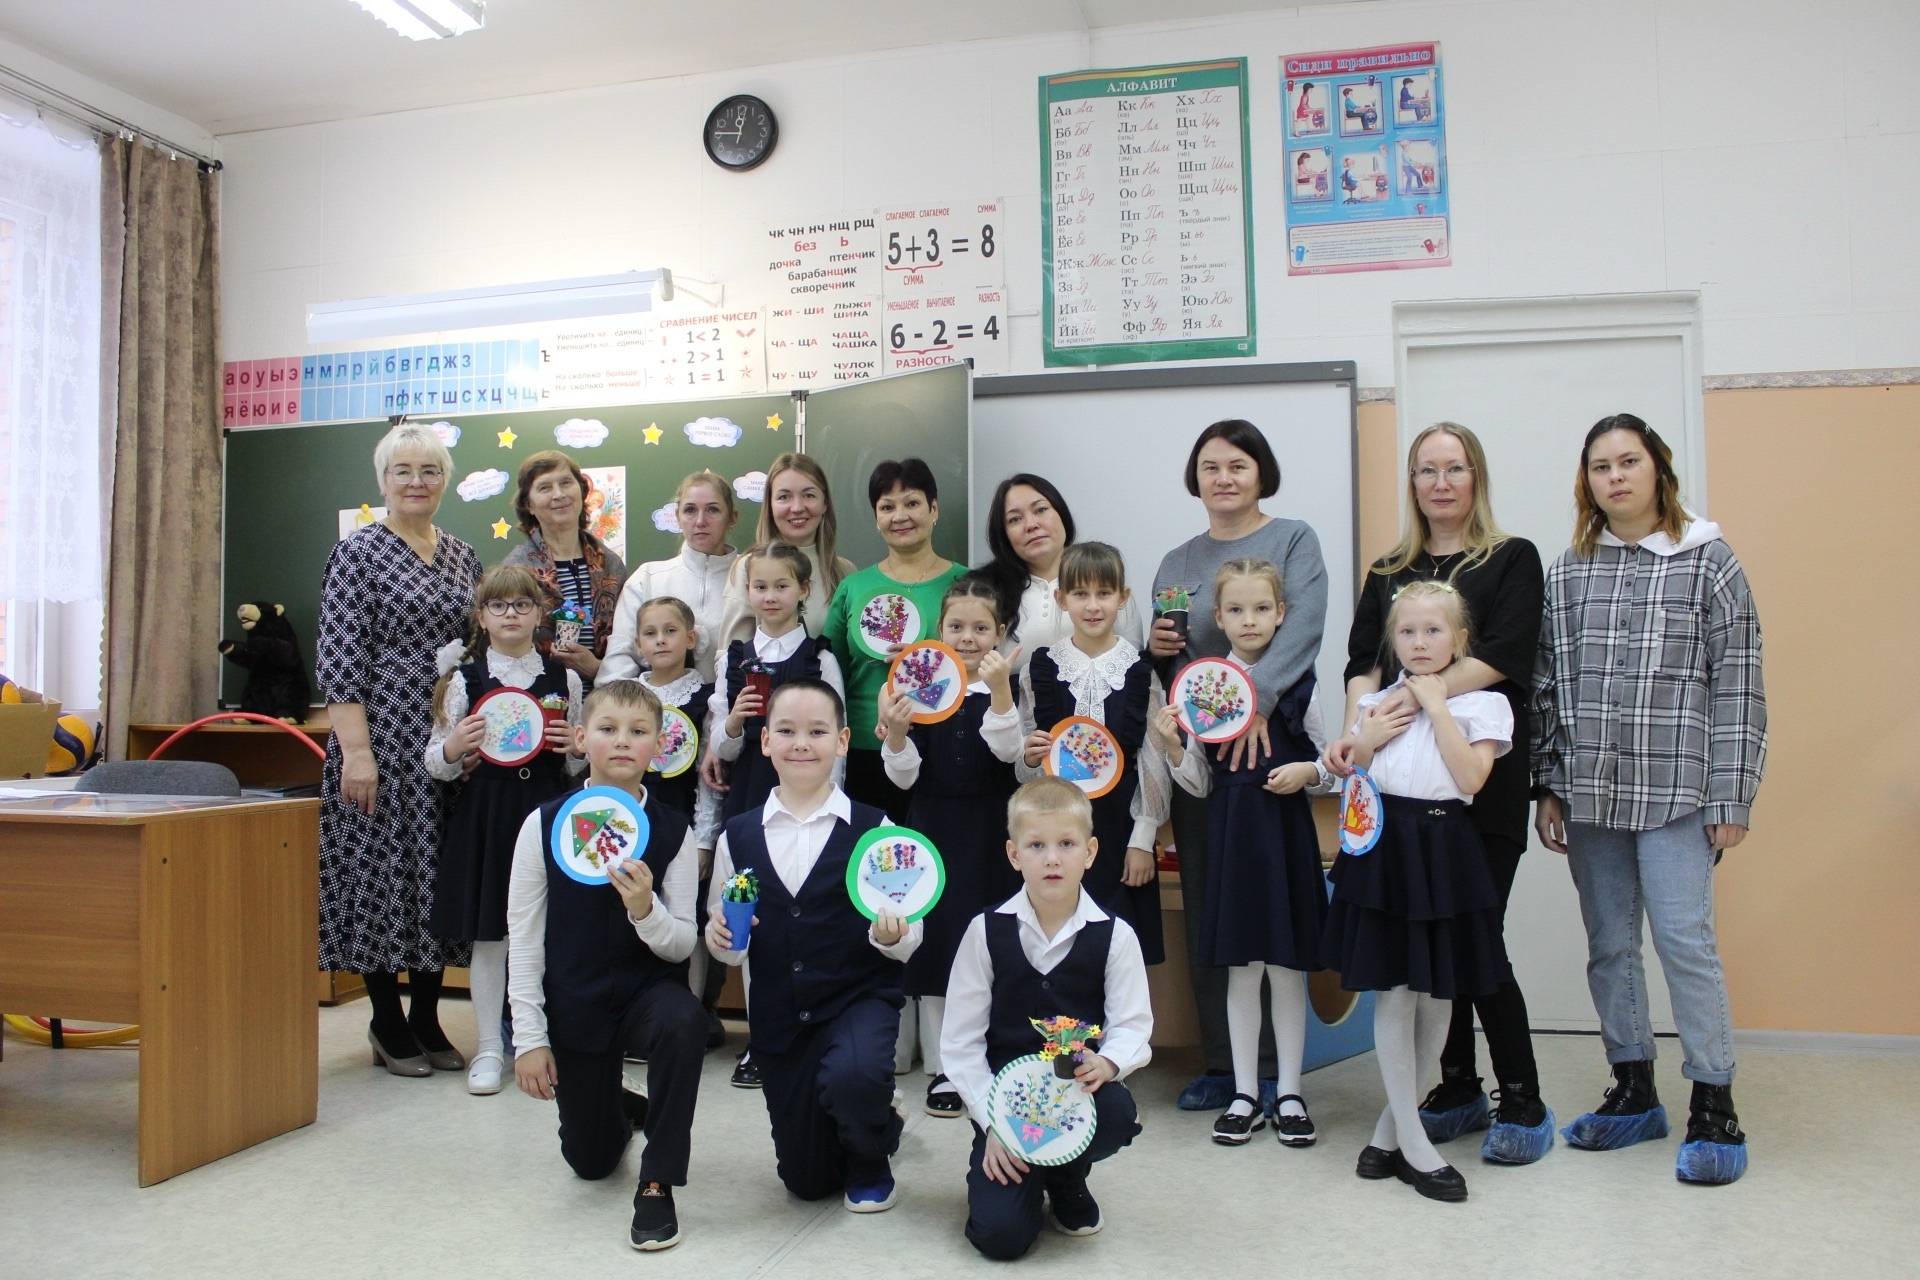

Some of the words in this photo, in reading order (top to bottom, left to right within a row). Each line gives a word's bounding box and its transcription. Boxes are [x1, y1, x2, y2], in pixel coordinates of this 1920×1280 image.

[1288, 59, 1332, 74] Сиди
[1337, 51, 1431, 69] правильно
[1107, 77, 1177, 93] АЛФАВИТ
[1118, 101, 1137, 110] Кк
[1176, 96, 1195, 106] Хх
[1054, 107, 1071, 117] Аа
[717, 119, 726, 128] 10
[758, 115, 765, 125] 2
[1177, 118, 1197, 129] Цц
[1118, 122, 1137, 133] Лл
[760, 128, 767, 138] 3
[1055, 127, 1071, 139] Бб
[718, 143, 724, 152] 8
[756, 140, 762, 150] 4
[1119, 145, 1141, 155] Мм
[1178, 140, 1196, 150] Чч
[727, 151, 732, 159] 7
[748, 150, 755, 158] 5
[1056, 150, 1071, 160] Вв
[1120, 166, 1139, 176] Нн
[1178, 162, 1206, 172] Шш
[1056, 172, 1070, 182] Гг
[1120, 188, 1137, 199] Оо
[1179, 183, 1207, 195] Щщ
[1057, 193, 1074, 205] Дд
[886, 211, 915, 220] СЛАГАЕМОЕ
[920, 208, 949, 218] СЛАГАЕМОЕ
[978, 204, 996, 213] СУММА
[1120, 211, 1140, 221] Пп
[1057, 216, 1072, 226] Ее
[769, 229, 784, 239] чк
[788, 227, 804, 236] чн
[809, 224, 825, 234] нч
[829, 221, 850, 232] нщ
[854, 218, 874, 231] рщ
[981, 224, 995, 258] 8
[1121, 233, 1138, 244] Рр
[794, 240, 817, 253] без
[769, 258, 801, 271] дочка
[829, 250, 875, 262] птенчик
[1058, 258, 1084, 269] Жж
[1122, 255, 1137, 265] Сс
[788, 266, 857, 281] барабанщик
[904, 275, 924, 285] СУММА
[1122, 277, 1138, 287] Тт
[1181, 274, 1197, 284] Ээ
[790, 280, 855, 294] скворечник
[1058, 282, 1073, 292] Зз
[834, 301, 871, 310] ЛЫЖИ
[887, 299, 919, 311] УМЕНЬШАЕМОЕ
[927, 296, 955, 308] ВЫЧИТАЕМОЕ
[979, 293, 1001, 303] РАЗНОСТЬ
[1123, 299, 1141, 310] Уу
[1182, 296, 1208, 306] Юю
[772, 309, 793, 317] ЖИ
[804, 307, 824, 315] ШИ
[834, 310, 869, 318] ШИНА
[1059, 304, 1078, 314] Ии
[660, 315, 719, 329] СРАВНЕНИЕ
[722, 311, 757, 322] ЧИСЕЛ
[1183, 319, 1201, 329] Яя
[983, 315, 999, 341] 4
[1059, 323, 1078, 337] Йй
[1123, 322, 1146, 334] Фф
[557, 332, 595, 341] Увеличить
[615, 328, 642, 337] единиц
[687, 331, 694, 343] 1
[712, 329, 720, 341] 2
[833, 331, 869, 339] ЧАЩА
[556, 343, 597, 351] Уменьшить
[617, 339, 644, 347] единиц
[833, 340, 877, 349] ЧАШКА
[687, 352, 695, 363] 2
[717, 349, 724, 361] 1
[834, 361, 874, 369] ЧУЛОК
[568, 371, 601, 380] сколько
[605, 369, 638, 377] больше
[688, 372, 695, 384] 1
[717, 369, 725, 381] 1
[834, 371, 869, 380] ЩУКА
[570, 382, 603, 390] сколько
[608, 380, 641, 388] меньше
